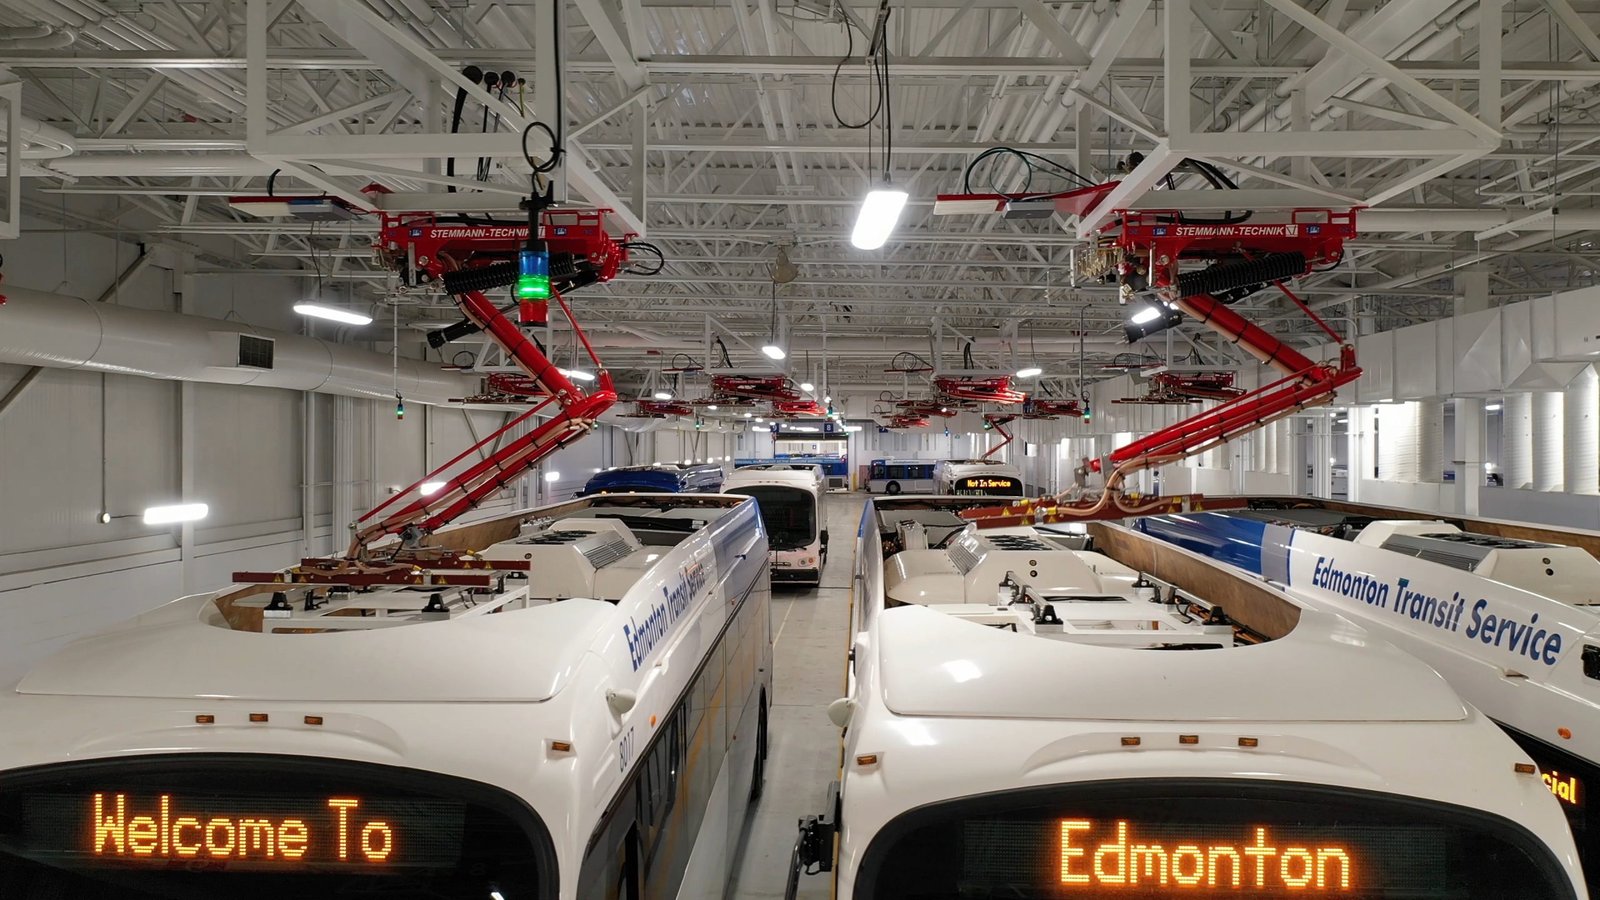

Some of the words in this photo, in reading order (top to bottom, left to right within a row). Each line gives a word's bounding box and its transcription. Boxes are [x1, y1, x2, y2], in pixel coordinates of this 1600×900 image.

[1176, 226, 1284, 236] STEMMANN-TECHNIK
[967, 479, 978, 488] Not
[979, 479, 987, 488] In
[988, 479, 1011, 488] Service
[623, 604, 668, 672] Edmonton
[662, 571, 688, 625] Transit
[1312, 557, 1389, 608] Edmonton
[1394, 577, 1465, 631] Transit
[1465, 599, 1562, 666] Service
[619, 726, 634, 773] 8017
[93, 793, 308, 857] Welcome
[328, 798, 393, 861] To
[1060, 819, 1351, 888] Edmonton
